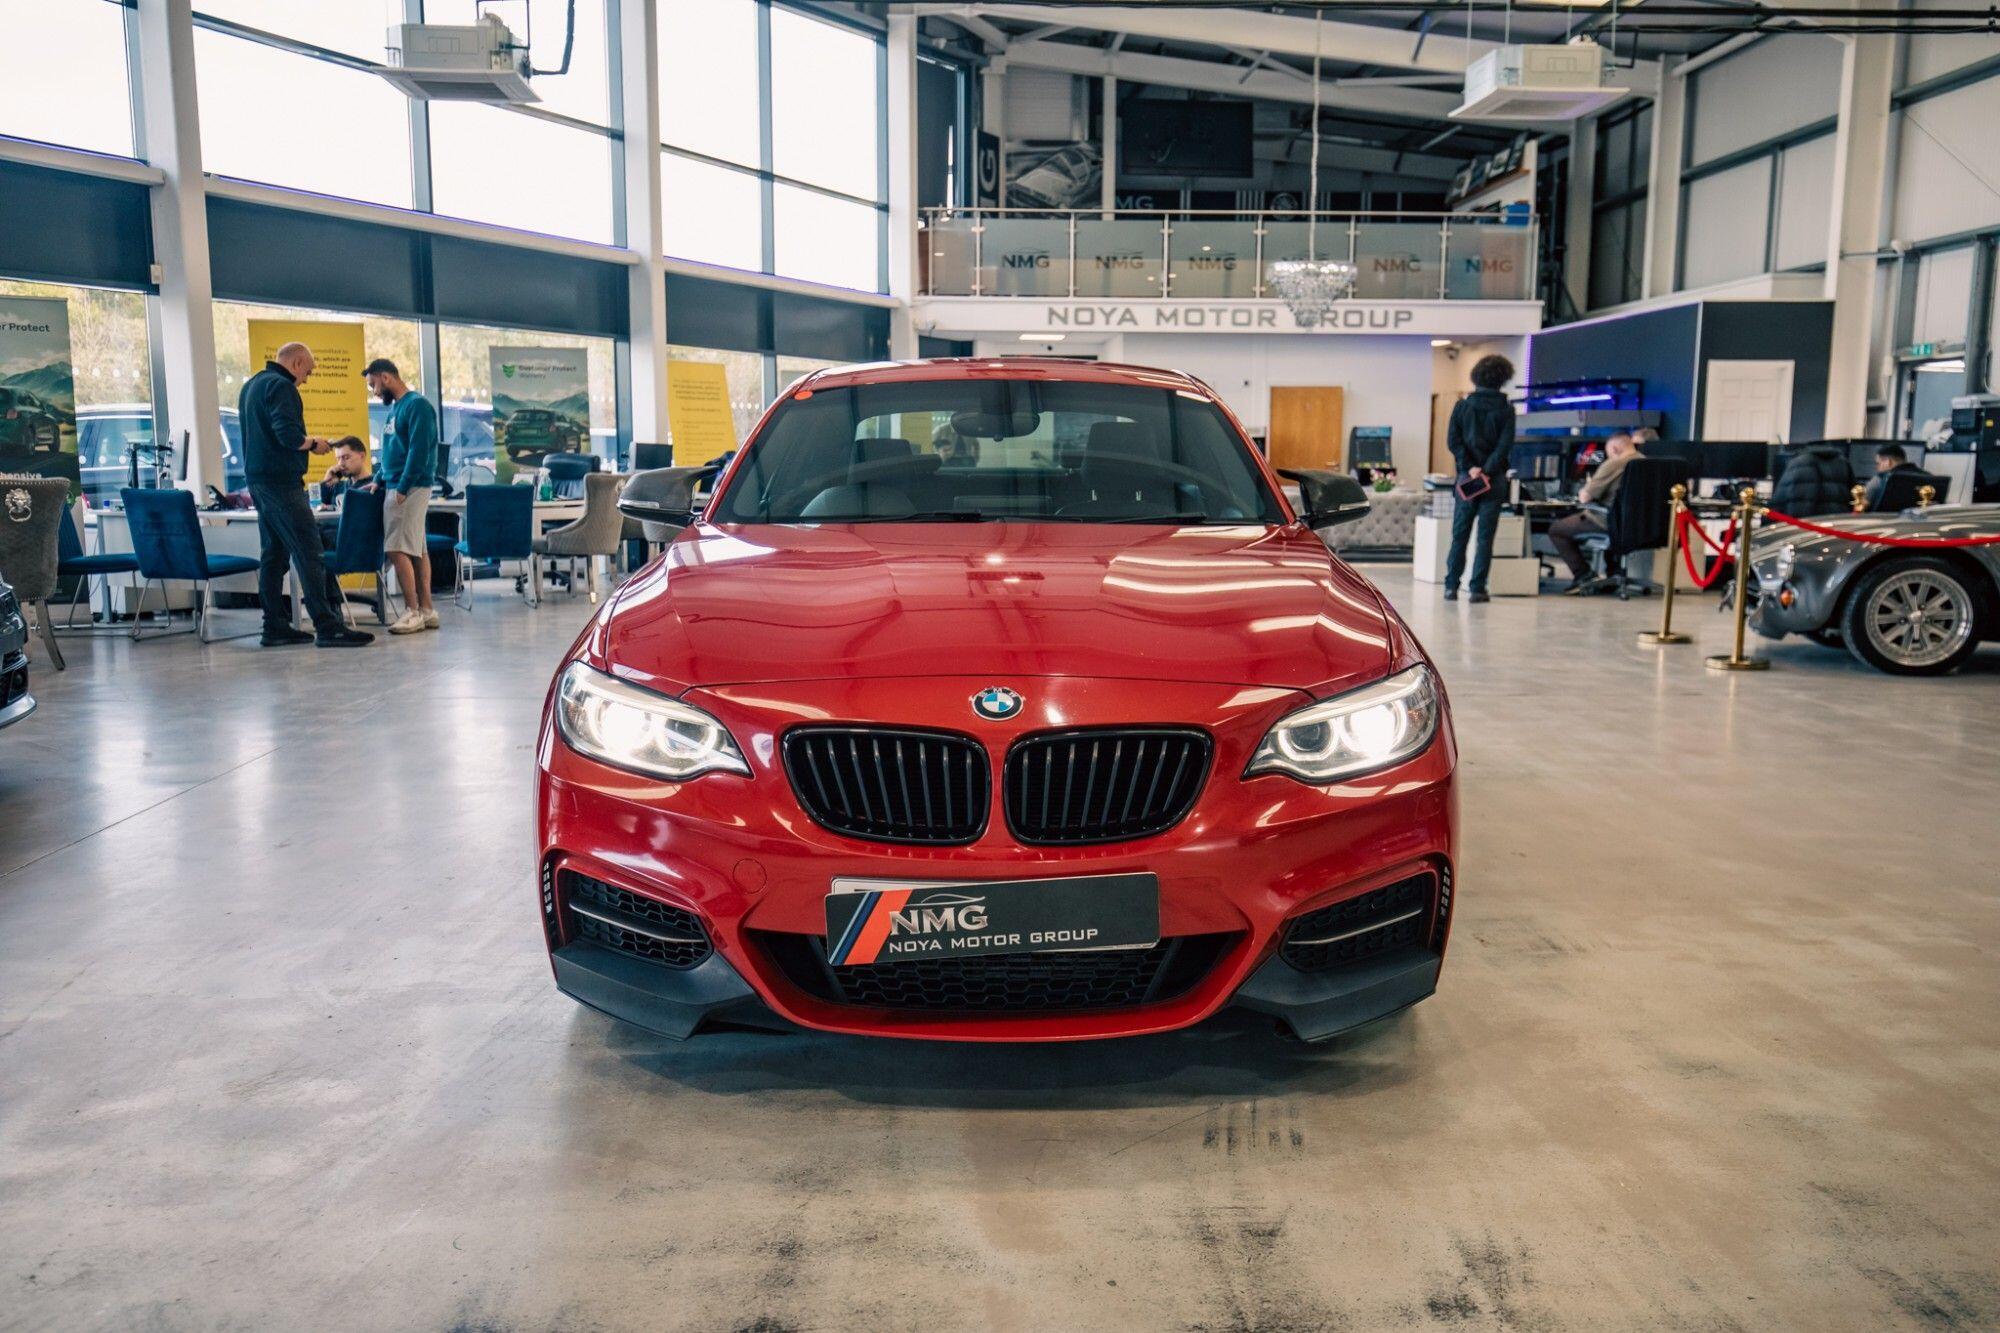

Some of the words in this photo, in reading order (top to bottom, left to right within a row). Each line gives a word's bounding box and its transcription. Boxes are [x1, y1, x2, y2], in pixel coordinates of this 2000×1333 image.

[1002, 254, 1050, 268] NMG
[1096, 256, 1144, 269] NMG
[1189, 257, 1237, 271] NMG
[1465, 258, 1513, 273] NMG
[1048, 307, 1138, 326] NOYA
[1156, 308, 1276, 327] MOTOR
[1295, 309, 1413, 328] ROUP
[9, 322, 50, 333] Protect
[889, 905, 989, 936] NMG
[889, 939, 942, 953] NOYA
[951, 933, 1021, 949] MOTOR
[1030, 928, 1099, 944] GROUP
